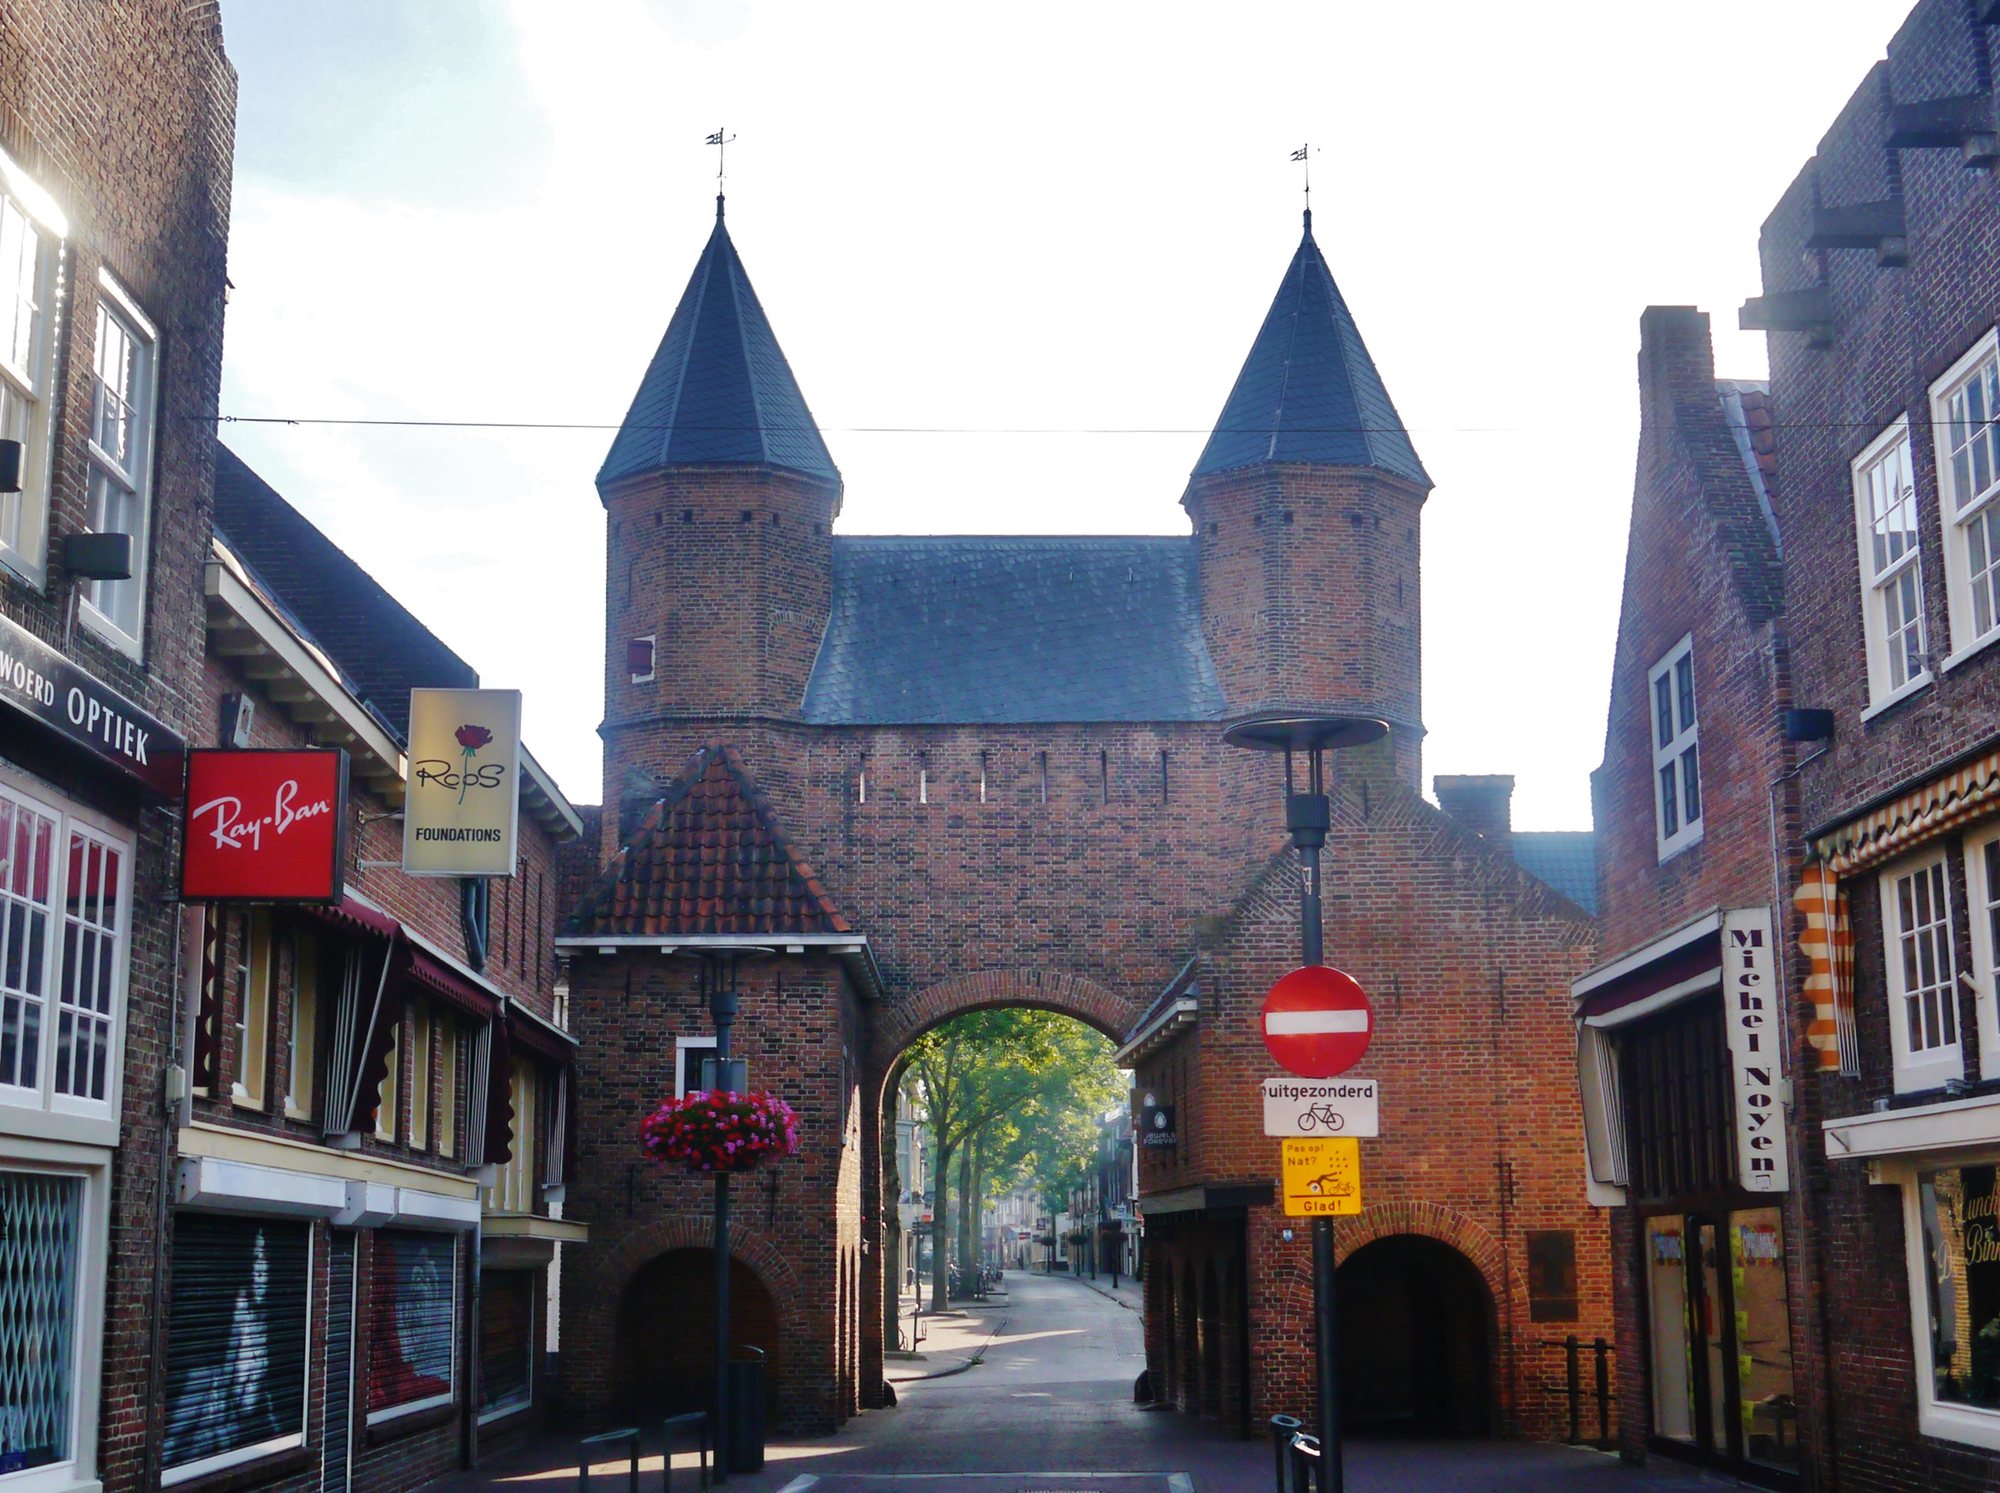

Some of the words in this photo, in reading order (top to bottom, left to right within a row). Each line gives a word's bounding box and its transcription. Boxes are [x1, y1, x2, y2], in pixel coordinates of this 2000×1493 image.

[67, 687, 149, 766] OPTIEK
[192, 779, 330, 851] Ray-Ban
[415, 828, 501, 842] FOUNDATIONS
[1729, 929, 1765, 1053] Michel
[1268, 1084, 1374, 1102] uitgezonderd
[1744, 1067, 1776, 1171] Noyen
[1286, 1144, 1306, 1153] Pas
[1308, 1143, 1325, 1153] op!
[1287, 1156, 1317, 1167] Nat?
[1303, 1199, 1343, 1212] Glad!
